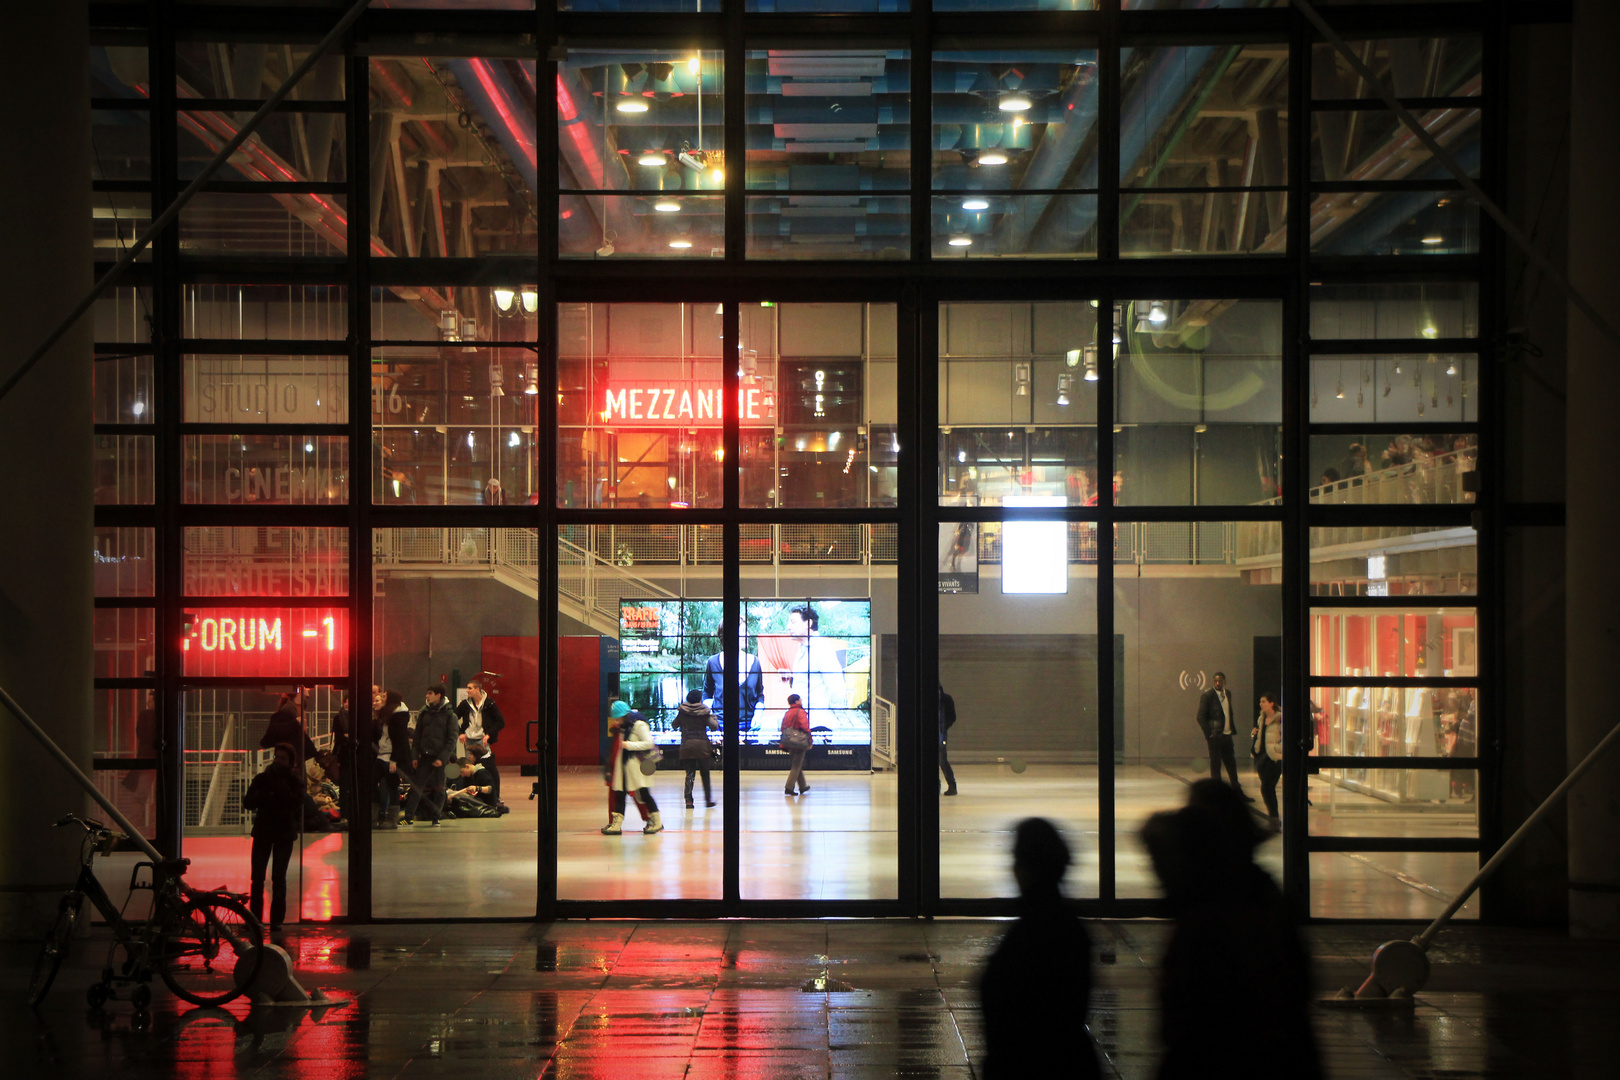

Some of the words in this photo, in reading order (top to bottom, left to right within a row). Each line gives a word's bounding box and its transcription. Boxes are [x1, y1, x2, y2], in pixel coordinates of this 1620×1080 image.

[203, 382, 298, 415] STUDIO
[184, 563, 282, 598] RANDE
[294, 563, 386, 598] SALE
[621, 606, 660, 621] TRAFIC
